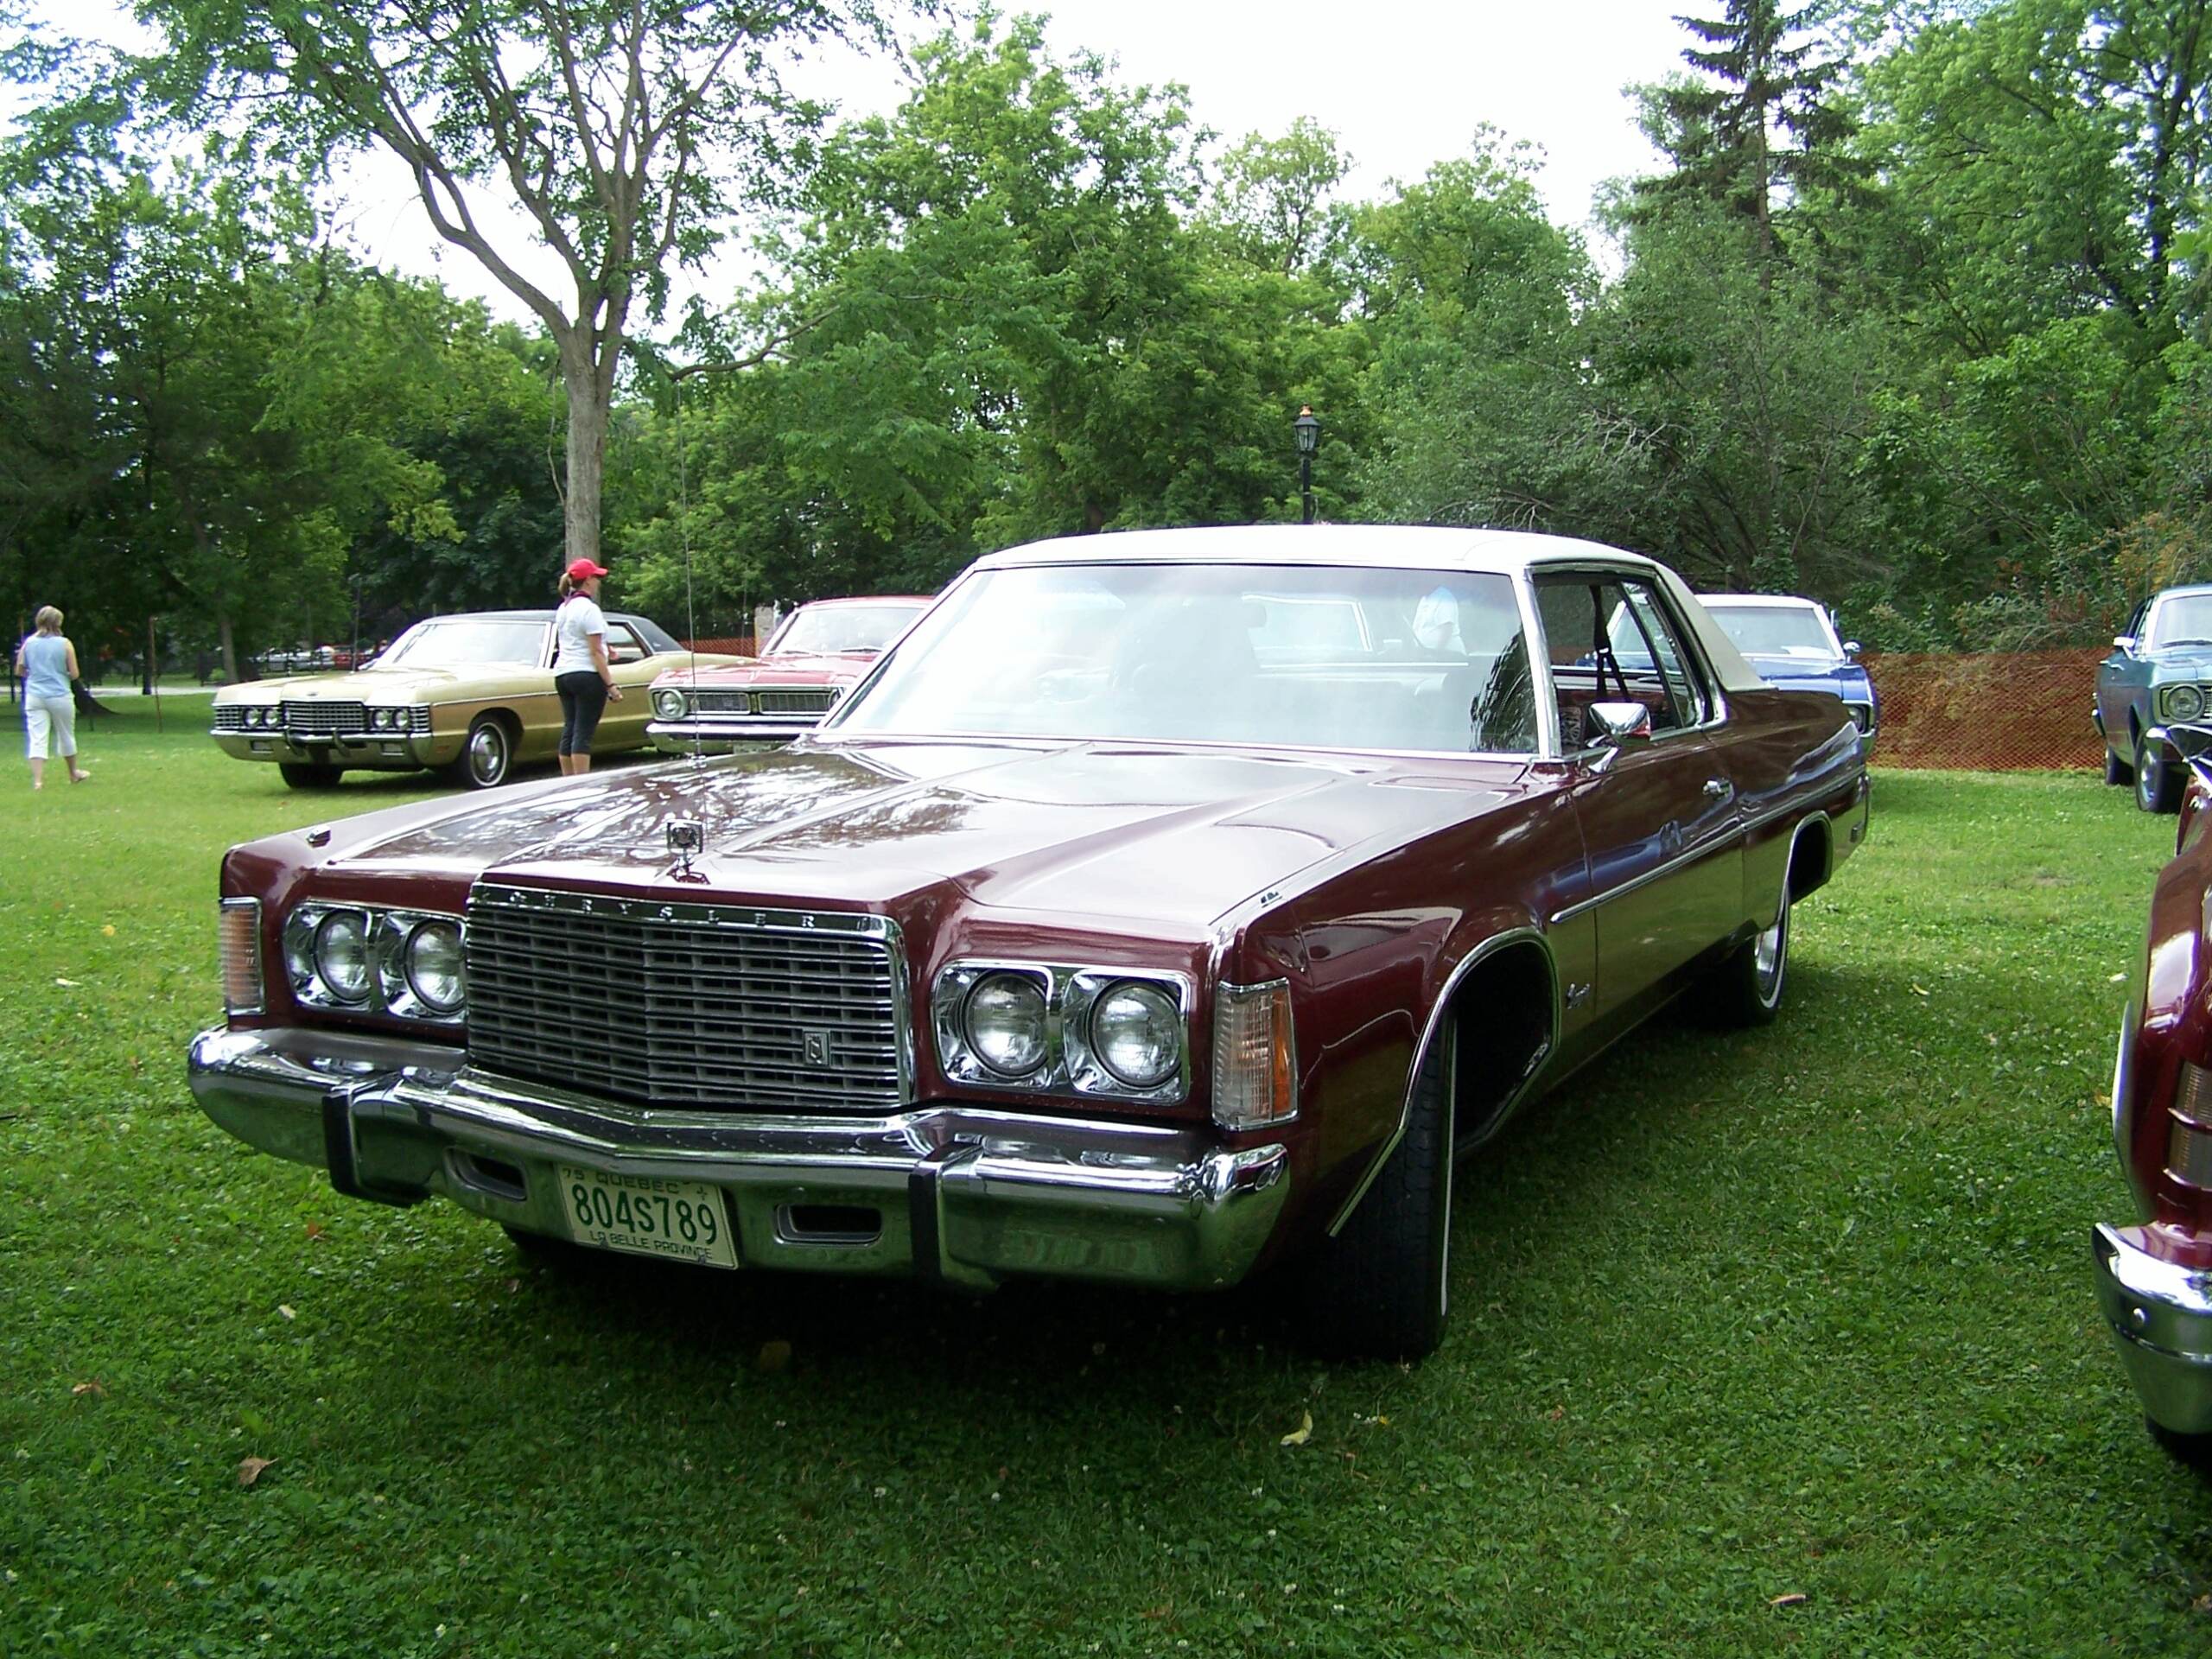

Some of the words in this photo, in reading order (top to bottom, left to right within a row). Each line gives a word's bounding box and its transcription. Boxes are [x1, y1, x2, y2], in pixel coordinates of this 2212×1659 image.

[510, 891, 815, 928] CHRYSLER
[571, 1183, 718, 1245] 804S789
[610, 1232, 650, 1249] BELLE
